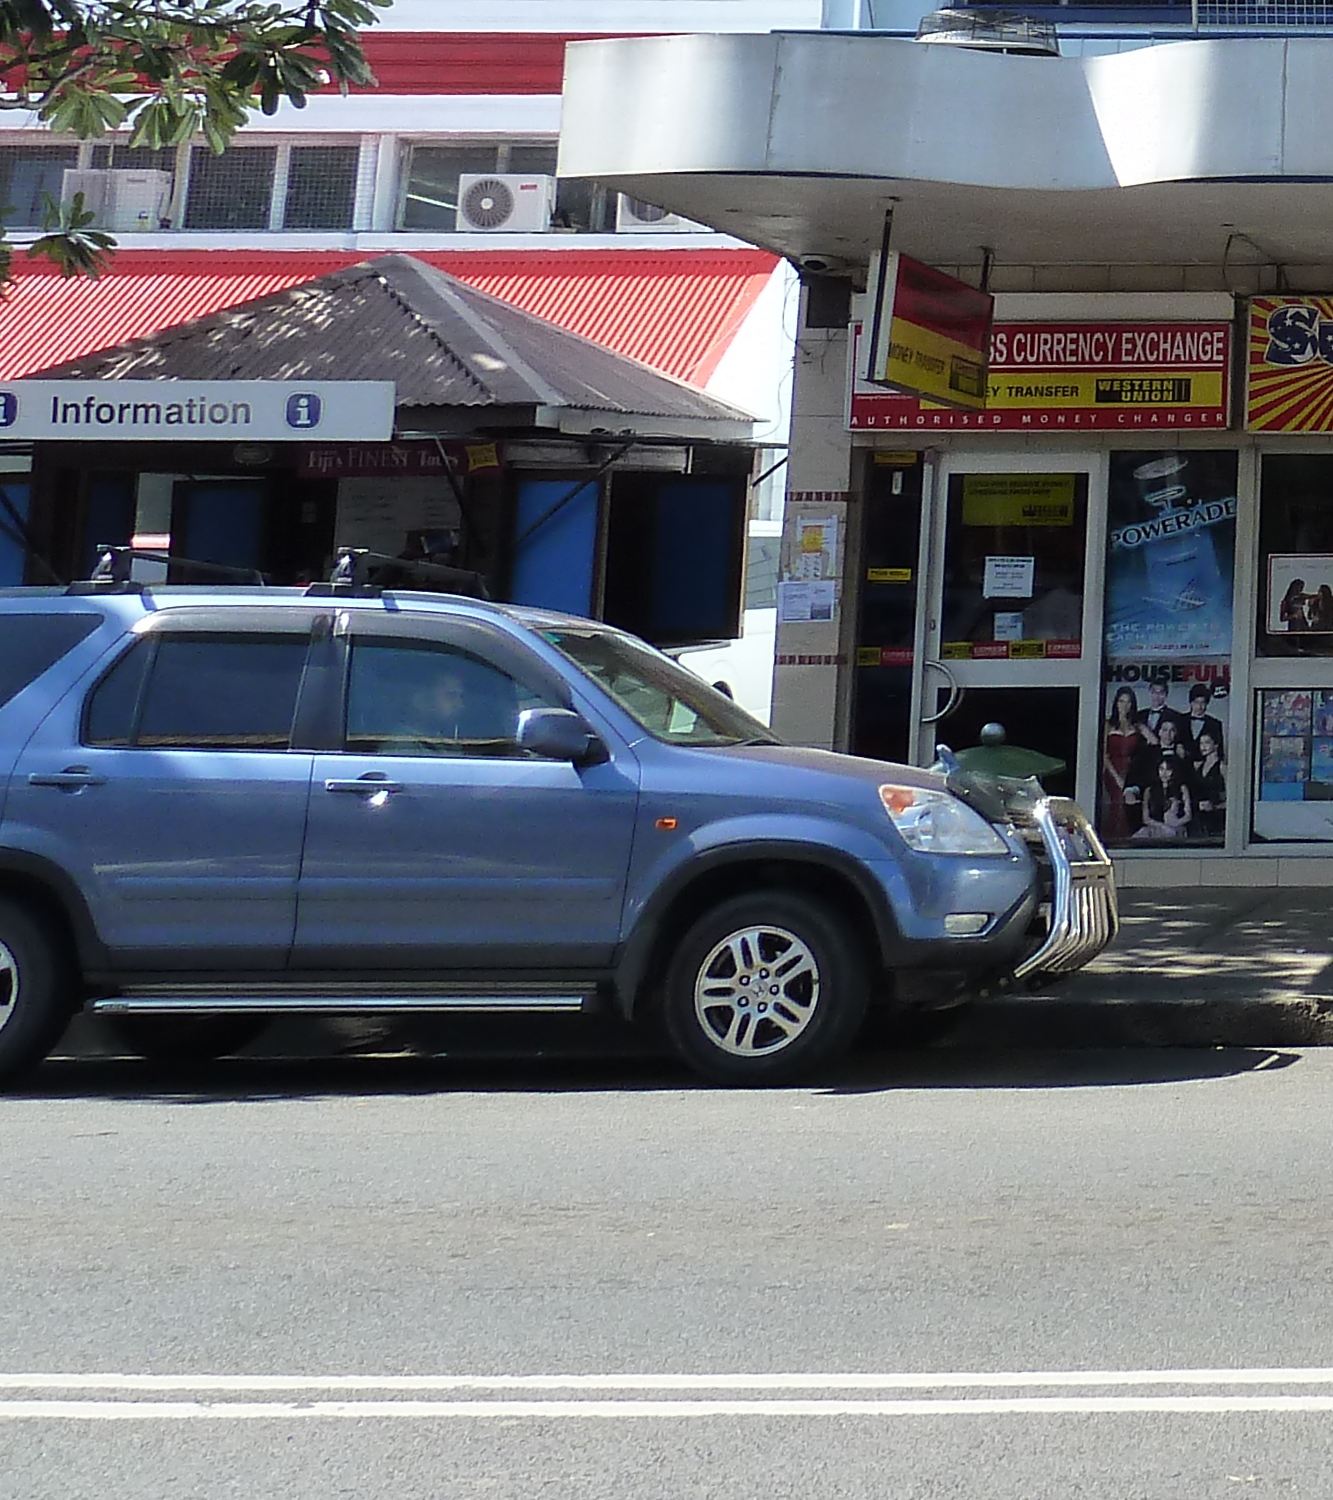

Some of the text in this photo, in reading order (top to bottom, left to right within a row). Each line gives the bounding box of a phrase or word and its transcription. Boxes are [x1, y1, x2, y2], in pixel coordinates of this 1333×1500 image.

[1013, 331, 1116, 363] CURRENCY
[1120, 331, 1225, 362] EXCHANGE
[1007, 385, 1080, 398] TRANSFER
[1098, 379, 1173, 391] WESTERN
[1120, 390, 1173, 401] UNION
[51, 396, 251, 425] Information
[850, 413, 1225, 426] AUTHORISED MONEY CHANGER
[1110, 497, 1236, 549] POWERADE
